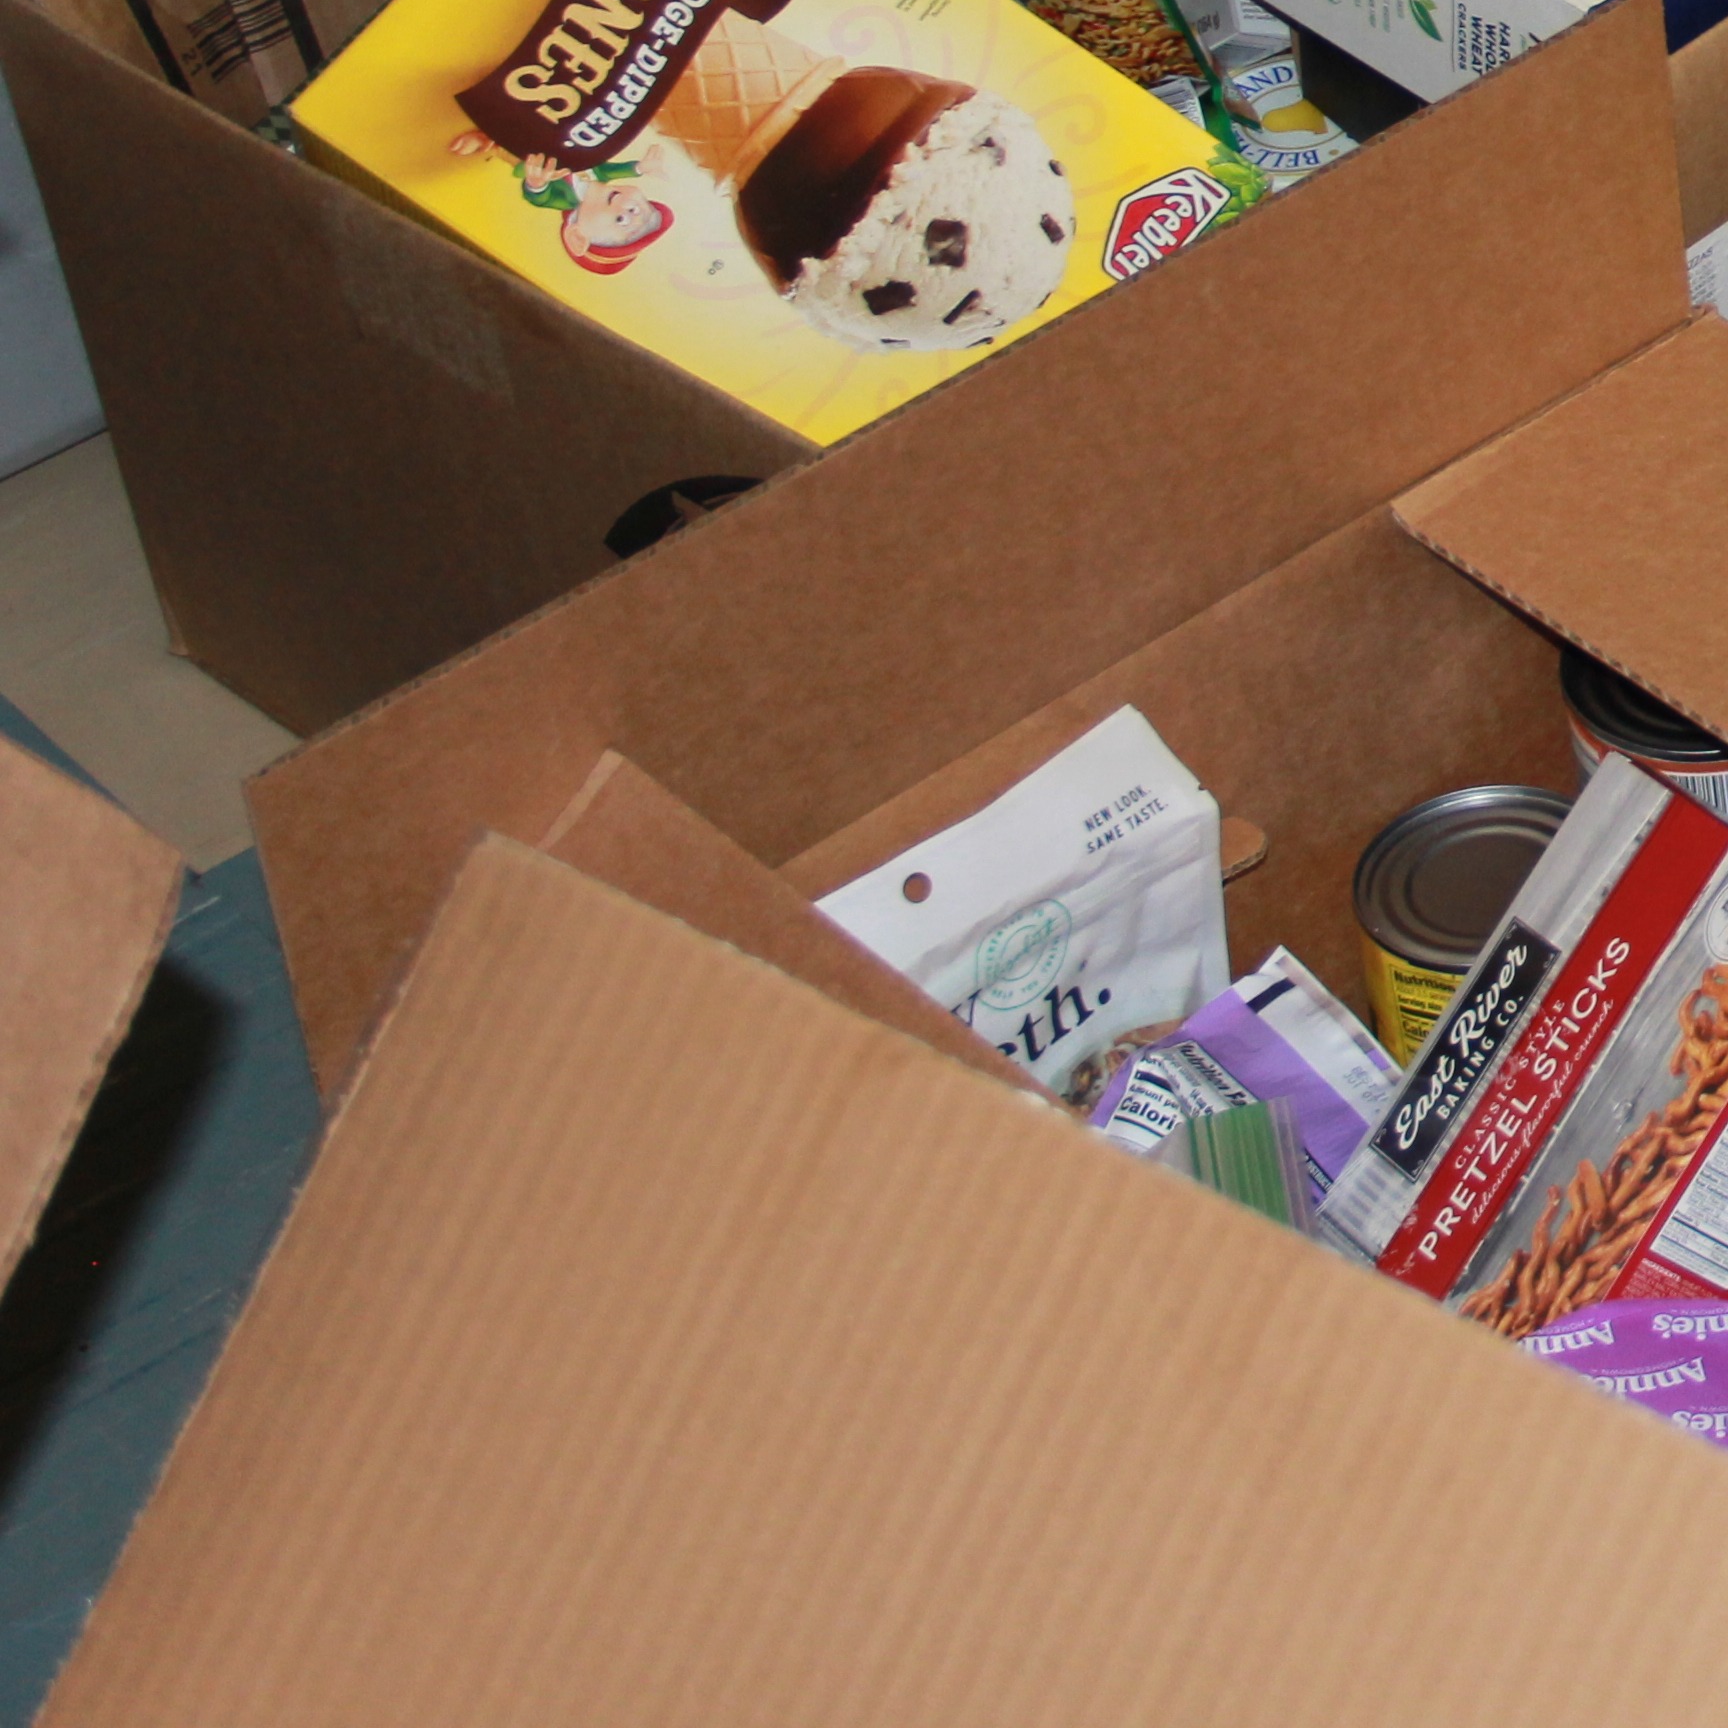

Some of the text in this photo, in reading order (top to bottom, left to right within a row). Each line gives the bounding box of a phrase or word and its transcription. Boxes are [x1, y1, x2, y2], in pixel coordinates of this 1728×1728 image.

[1112, 169, 1226, 279] Keebler
[1083, 784, 1152, 834] NEW LOOK.
[1084, 796, 1170, 855] SAME TASTE.
[1395, 1057, 1455, 1151] East
[1450, 943, 1528, 1059] River
[1418, 1093, 1538, 1261] PRETZEL
[1532, 936, 1631, 1082] STICKS
[1436, 996, 1524, 1121] BAKING CO.
